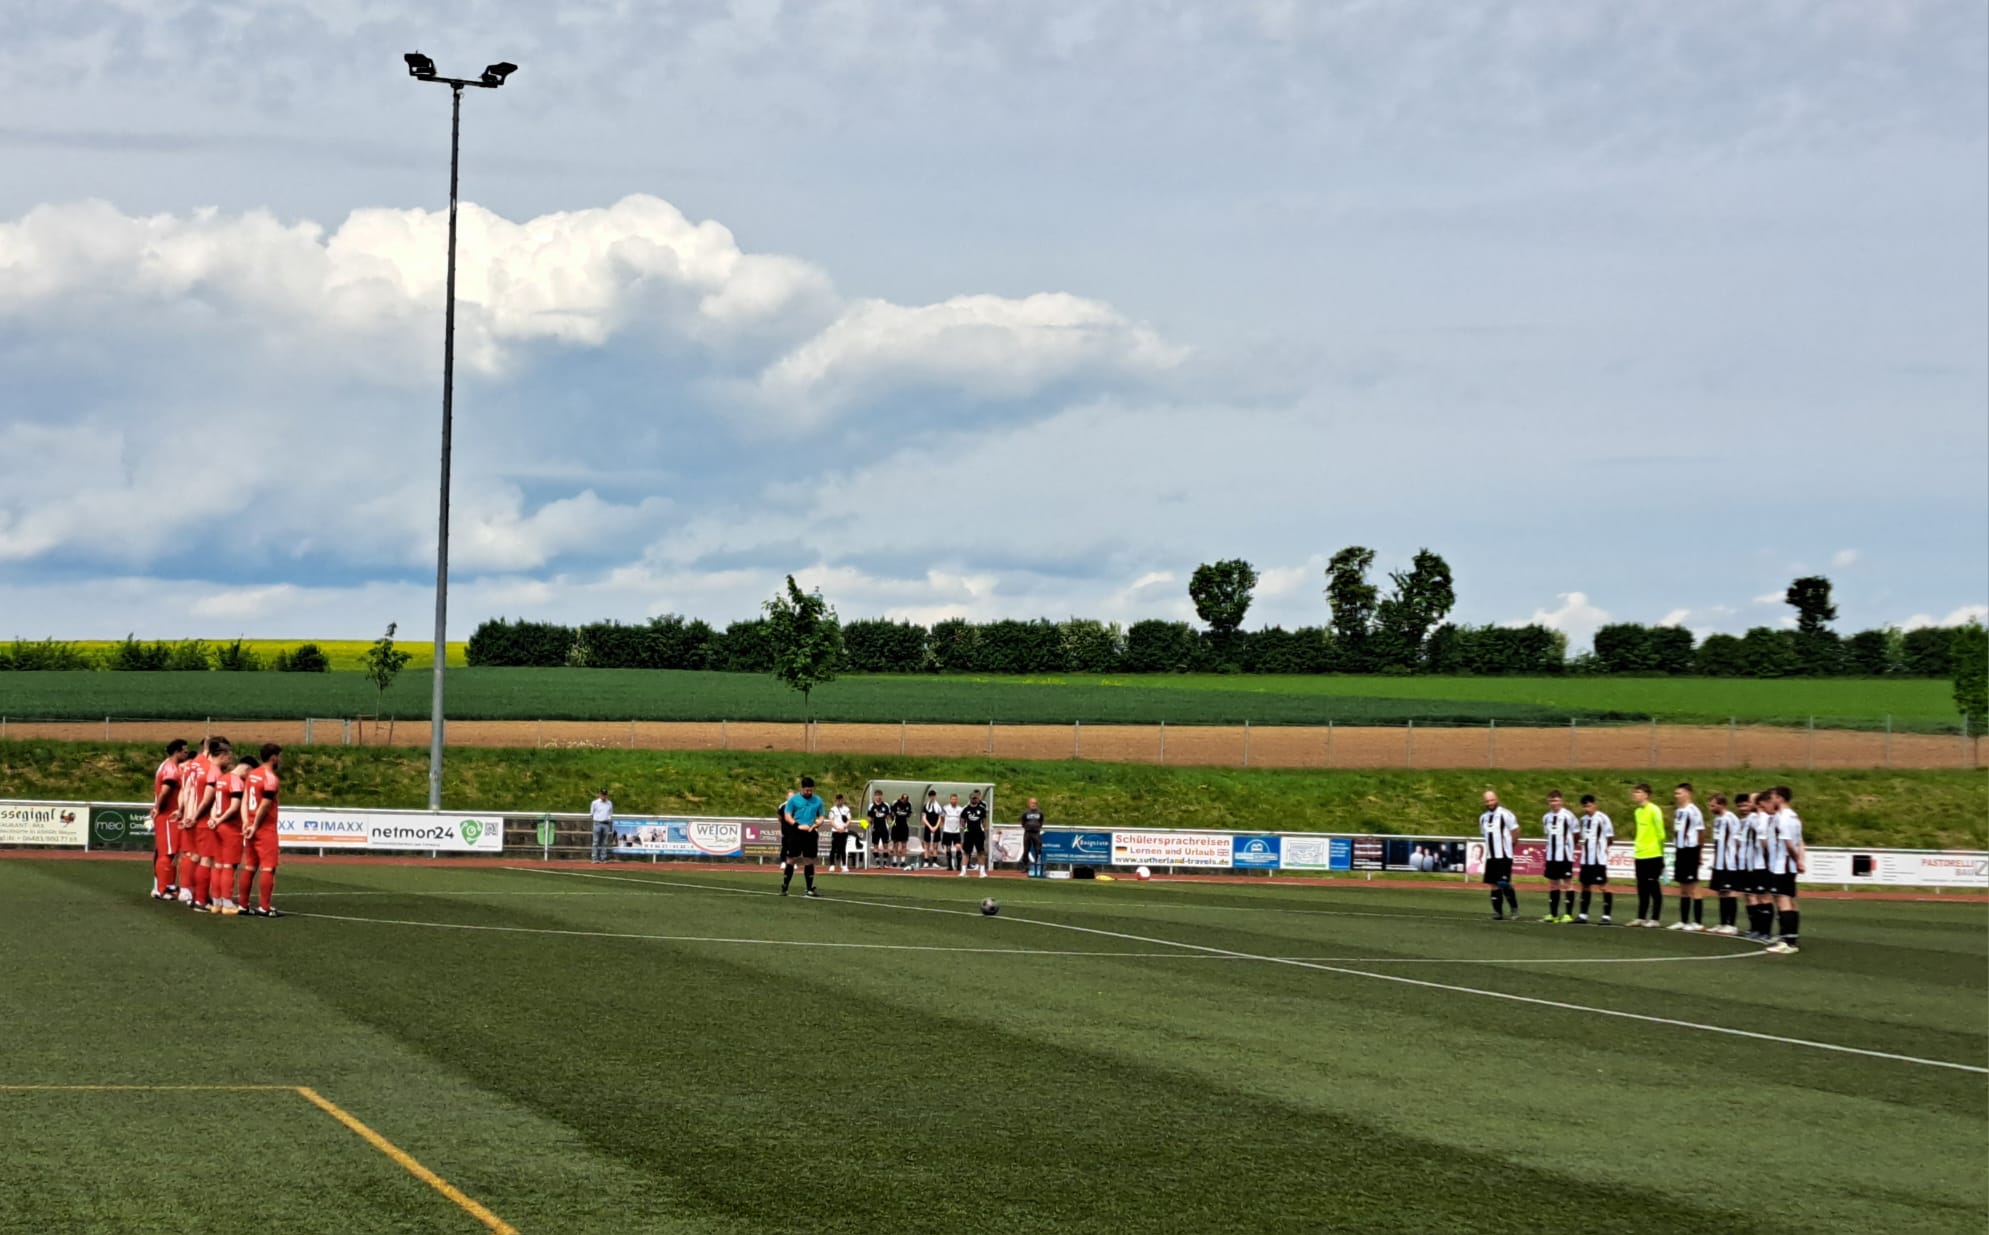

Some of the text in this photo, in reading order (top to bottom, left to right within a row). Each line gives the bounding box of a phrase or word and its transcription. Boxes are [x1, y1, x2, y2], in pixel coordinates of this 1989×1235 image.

[249, 786, 258, 811] 6
[320, 821, 364, 832] IMAXX
[372, 826, 454, 839] netmon24
[1115, 834, 1230, 847] Schülersprachreisen
[1130, 847, 1216, 856] Lernen und Urlaub
